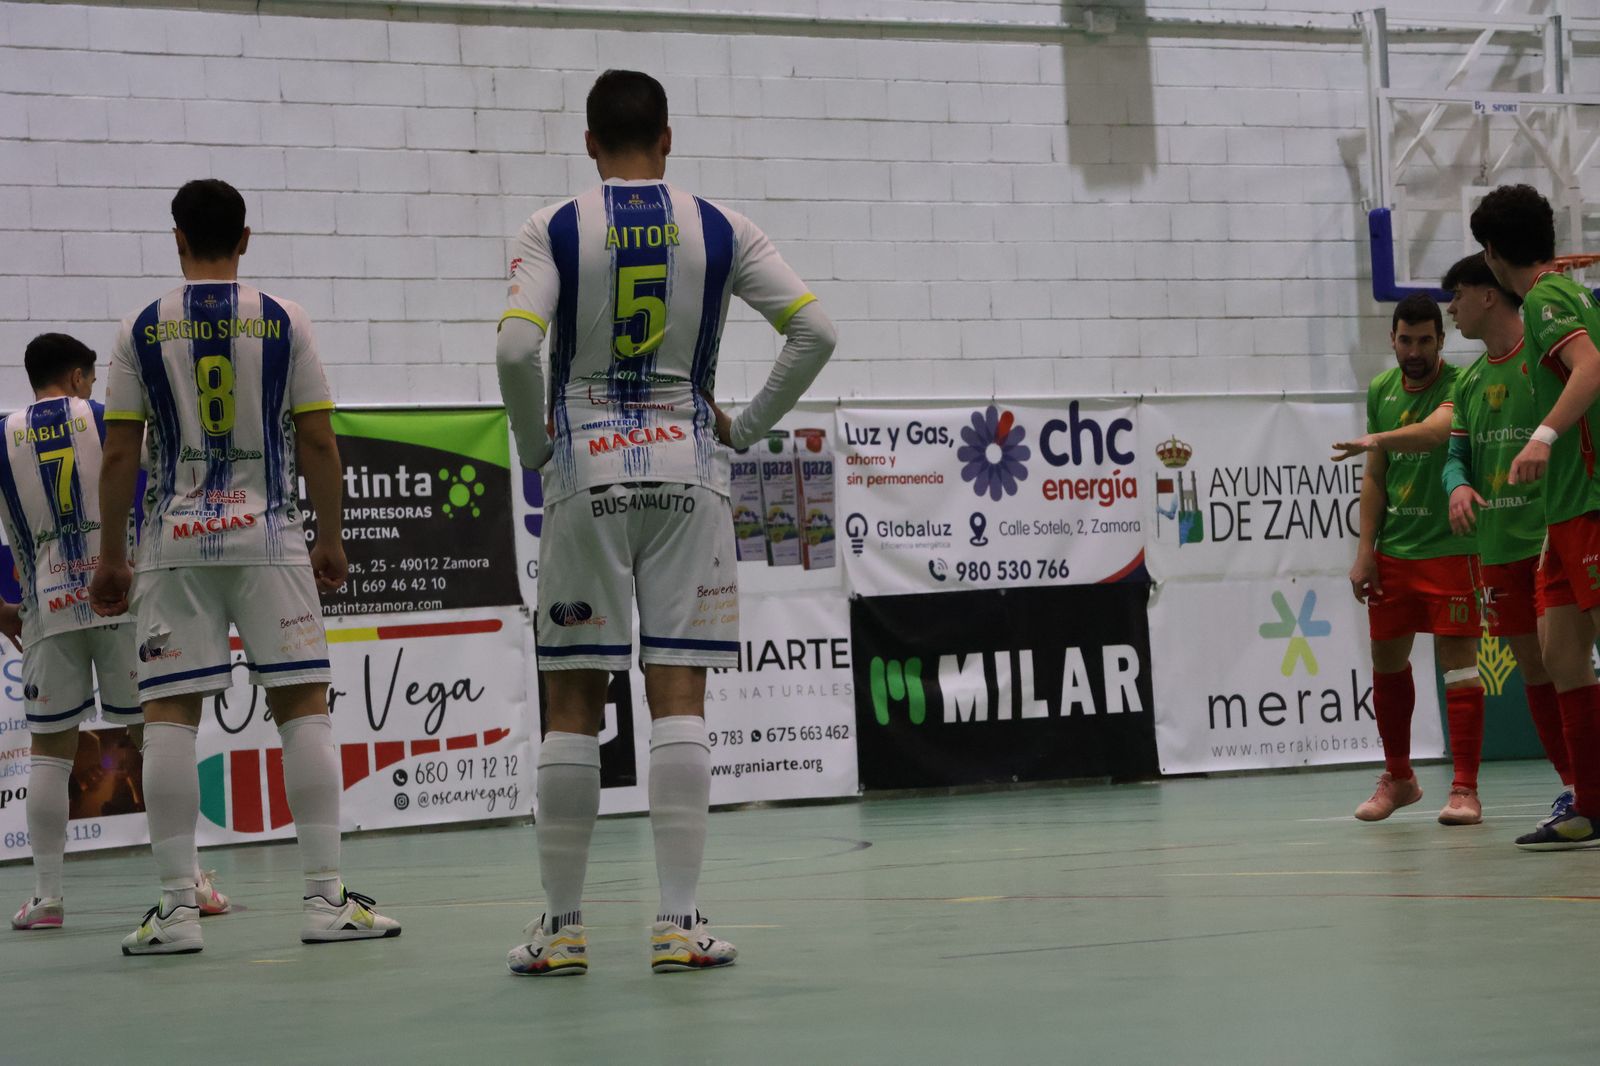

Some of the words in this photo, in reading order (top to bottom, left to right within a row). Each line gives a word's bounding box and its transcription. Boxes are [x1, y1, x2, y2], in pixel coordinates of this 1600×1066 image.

[606, 223, 680, 249] AITOR
[612, 263, 668, 360] 5
[144, 319, 213, 345] SERGIO
[194, 354, 236, 437] 8
[14, 414, 88, 447] PABLITO
[588, 425, 686, 456] MACIAS
[844, 421, 881, 446] Luz
[887, 427, 900, 451] y
[906, 420, 955, 449] Gas,
[1038, 399, 1136, 467] chc
[762, 460, 793, 481] gaza
[802, 460, 833, 481] gaza
[845, 453, 886, 467] ahorro
[888, 455, 897, 469] y
[38, 446, 76, 517] 7
[846, 471, 864, 486] sin
[866, 470, 945, 489] permanencia
[1041, 468, 1138, 508] energía
[1208, 463, 1364, 498] AYUNTAMIE
[207, 489, 247, 500] VALLES
[343, 506, 432, 521] IMPRESORAS
[1209, 500, 1253, 542] DE
[1261, 497, 1361, 541] ZAMO
[172, 513, 258, 541] MACIAS
[341, 526, 400, 541] OFICINA
[876, 519, 953, 538] Globaluz
[999, 519, 1032, 537] Calle
[1033, 518, 1074, 538] Sotelo,
[1076, 519, 1088, 537] 2,
[1091, 517, 1142, 535] Zamora
[47, 545, 67, 575] LOS
[370, 559, 387, 573] 25
[399, 557, 439, 571] 49012
[442, 556, 490, 570] Zamora
[955, 560, 991, 582] 980
[996, 559, 1032, 581] 530
[1036, 558, 1071, 580] 766
[361, 578, 387, 593] 669
[391, 578, 407, 592] 46
[411, 577, 427, 592] 42
[431, 576, 447, 591] 10
[47, 588, 90, 614] MAC
[320, 599, 443, 616] natintazamora.com
[1448, 603, 1470, 624] 10
[364, 646, 486, 736] Vega
[738, 682, 854, 699] NATURALES
[937, 643, 1144, 724] MILAR
[1207, 668, 1377, 729] merak
[721, 729, 744, 746] 783
[766, 727, 797, 742] 675
[799, 725, 823, 741] 663
[825, 724, 850, 740] 462
[1211, 734, 1384, 758] www.merakiobras.e
[415, 760, 449, 785] 680
[456, 758, 474, 782] 91
[711, 756, 824, 779] ww.graniarte.org
[417, 781, 521, 813] @oscarvegacj
[73, 822, 102, 841] 119
